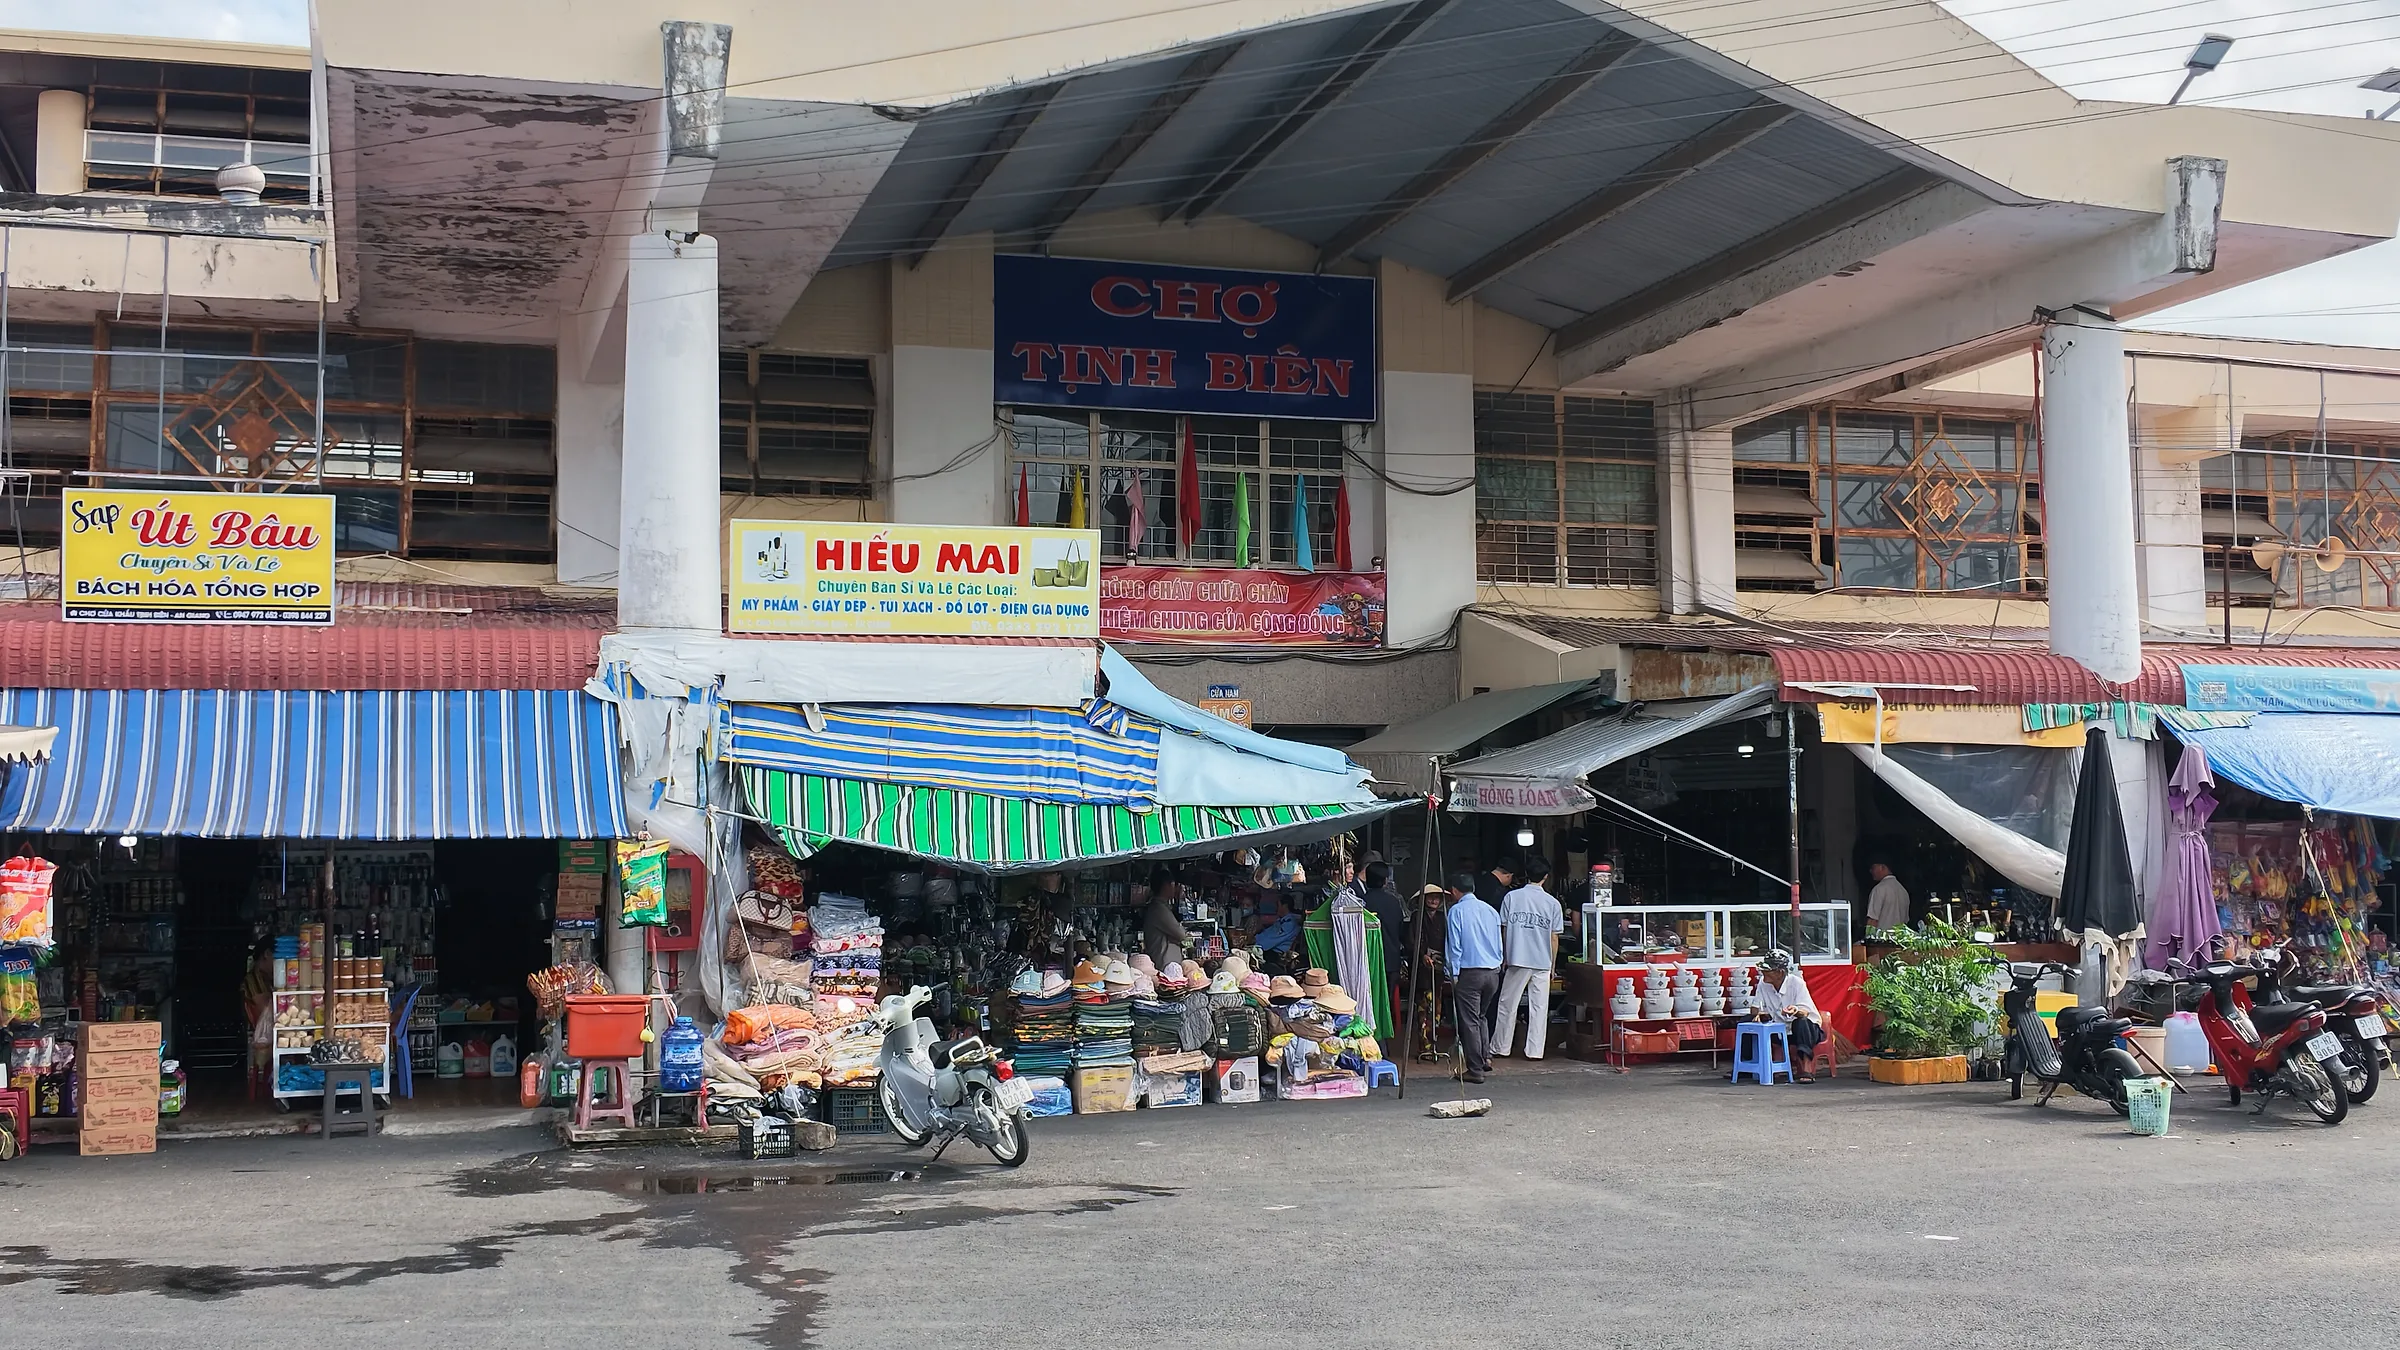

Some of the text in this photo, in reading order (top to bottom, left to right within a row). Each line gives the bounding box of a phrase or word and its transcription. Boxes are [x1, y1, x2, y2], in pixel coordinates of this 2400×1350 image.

[1091, 275, 1280, 338] CHỢ
[1012, 342, 1354, 398] TỊNH BIÊN
[71, 499, 123, 533] Sạp
[131, 500, 198, 547] Út
[120, 553, 190, 574] Chuyên
[816, 531, 1019, 575] HIẾU MAI
[77, 576, 320, 602] BÁCH HÓA TỔNG HỢP
[818, 580, 867, 595] Chuyên
[919, 582, 934, 595] Và
[958, 582, 982, 595] Các
[1149, 577, 1193, 601] CHÁY
[1197, 579, 1243, 602] CHỮA
[1247, 581, 1290, 604] CHÁY
[1032, 603, 1052, 615] GIA
[1056, 604, 1090, 619] DỤNG
[1149, 610, 1208, 632] CHUNG
[1212, 607, 1247, 633] CỦA
[1250, 610, 1297, 636] CỘNG
[1298, 608, 1345, 634] ĐỒNG
